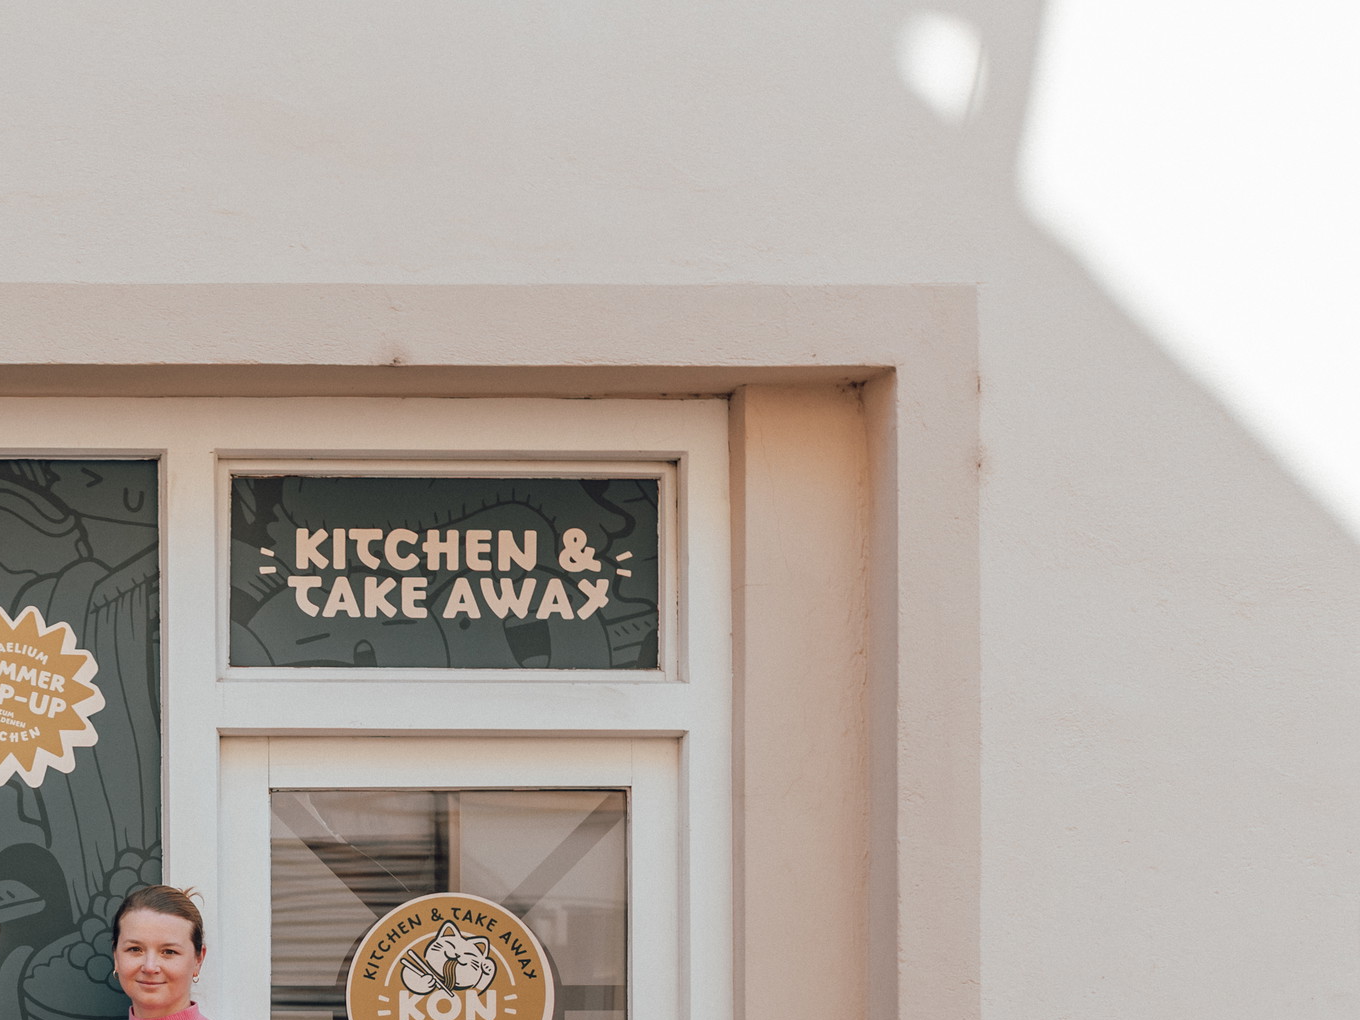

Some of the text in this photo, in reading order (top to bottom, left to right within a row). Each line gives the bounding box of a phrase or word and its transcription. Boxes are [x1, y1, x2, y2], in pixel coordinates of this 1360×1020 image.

[295, 527, 602, 572] KITCHEN &
[287, 575, 610, 620] TAKE AWAY
[363, 907, 538, 980] KITCHEN & TAKE AWAY
